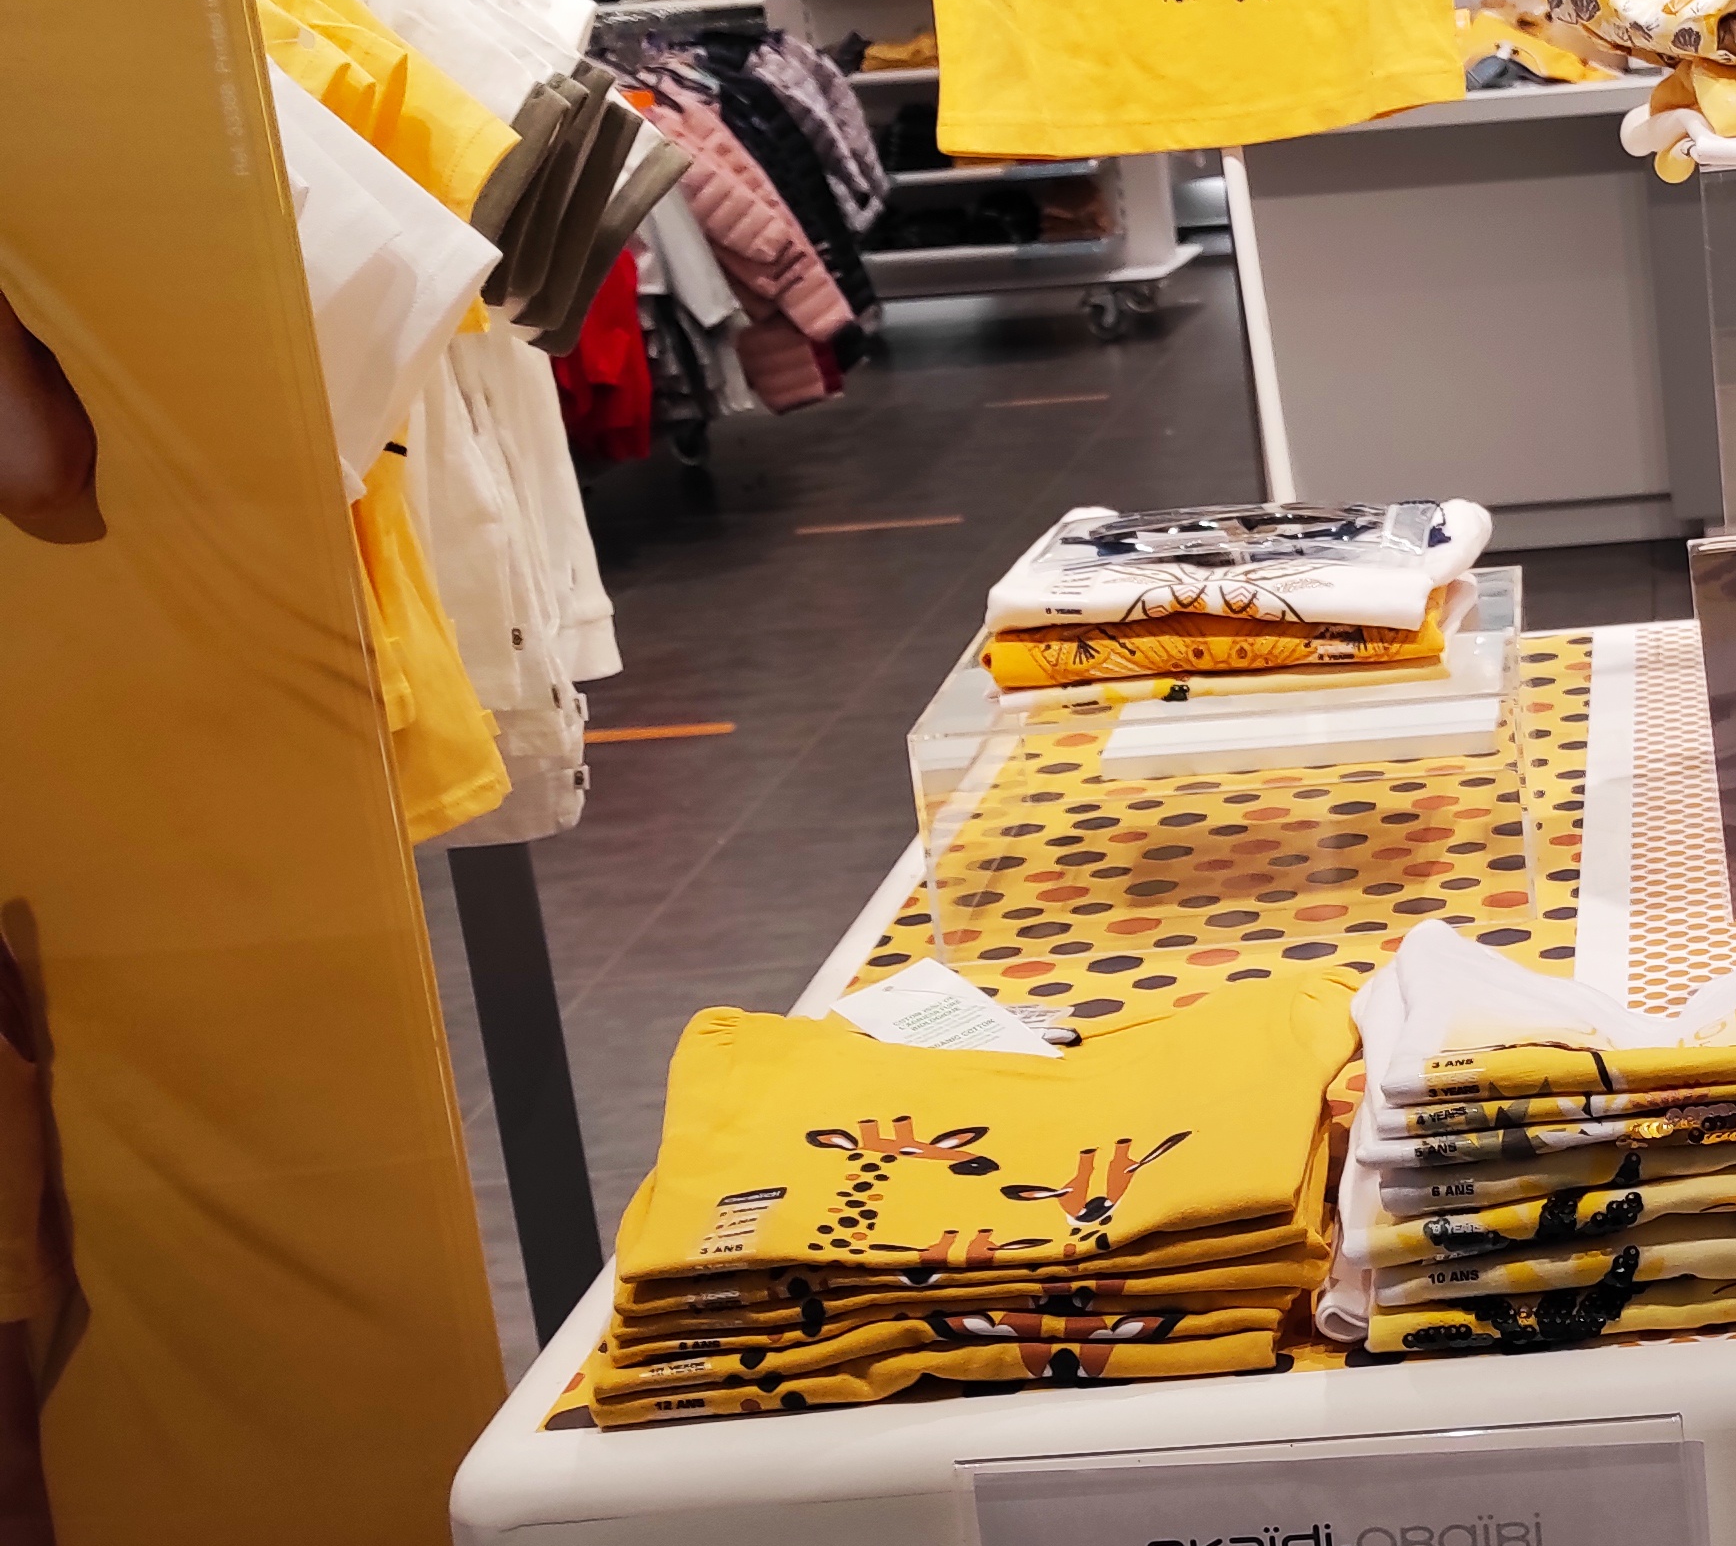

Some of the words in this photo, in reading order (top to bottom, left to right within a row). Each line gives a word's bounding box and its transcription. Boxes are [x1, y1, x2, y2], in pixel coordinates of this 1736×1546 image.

[1445, 1058, 1474, 1068] ANS
[1441, 1084, 1481, 1096] YEARS
[1431, 1186, 1441, 1197] 6
[1445, 1184, 1475, 1196] ANS
[713, 1243, 744, 1254] ANS
[1428, 1272, 1446, 1285] 10
[1450, 1269, 1480, 1283] ANS
[676, 1398, 706, 1409] ANS
